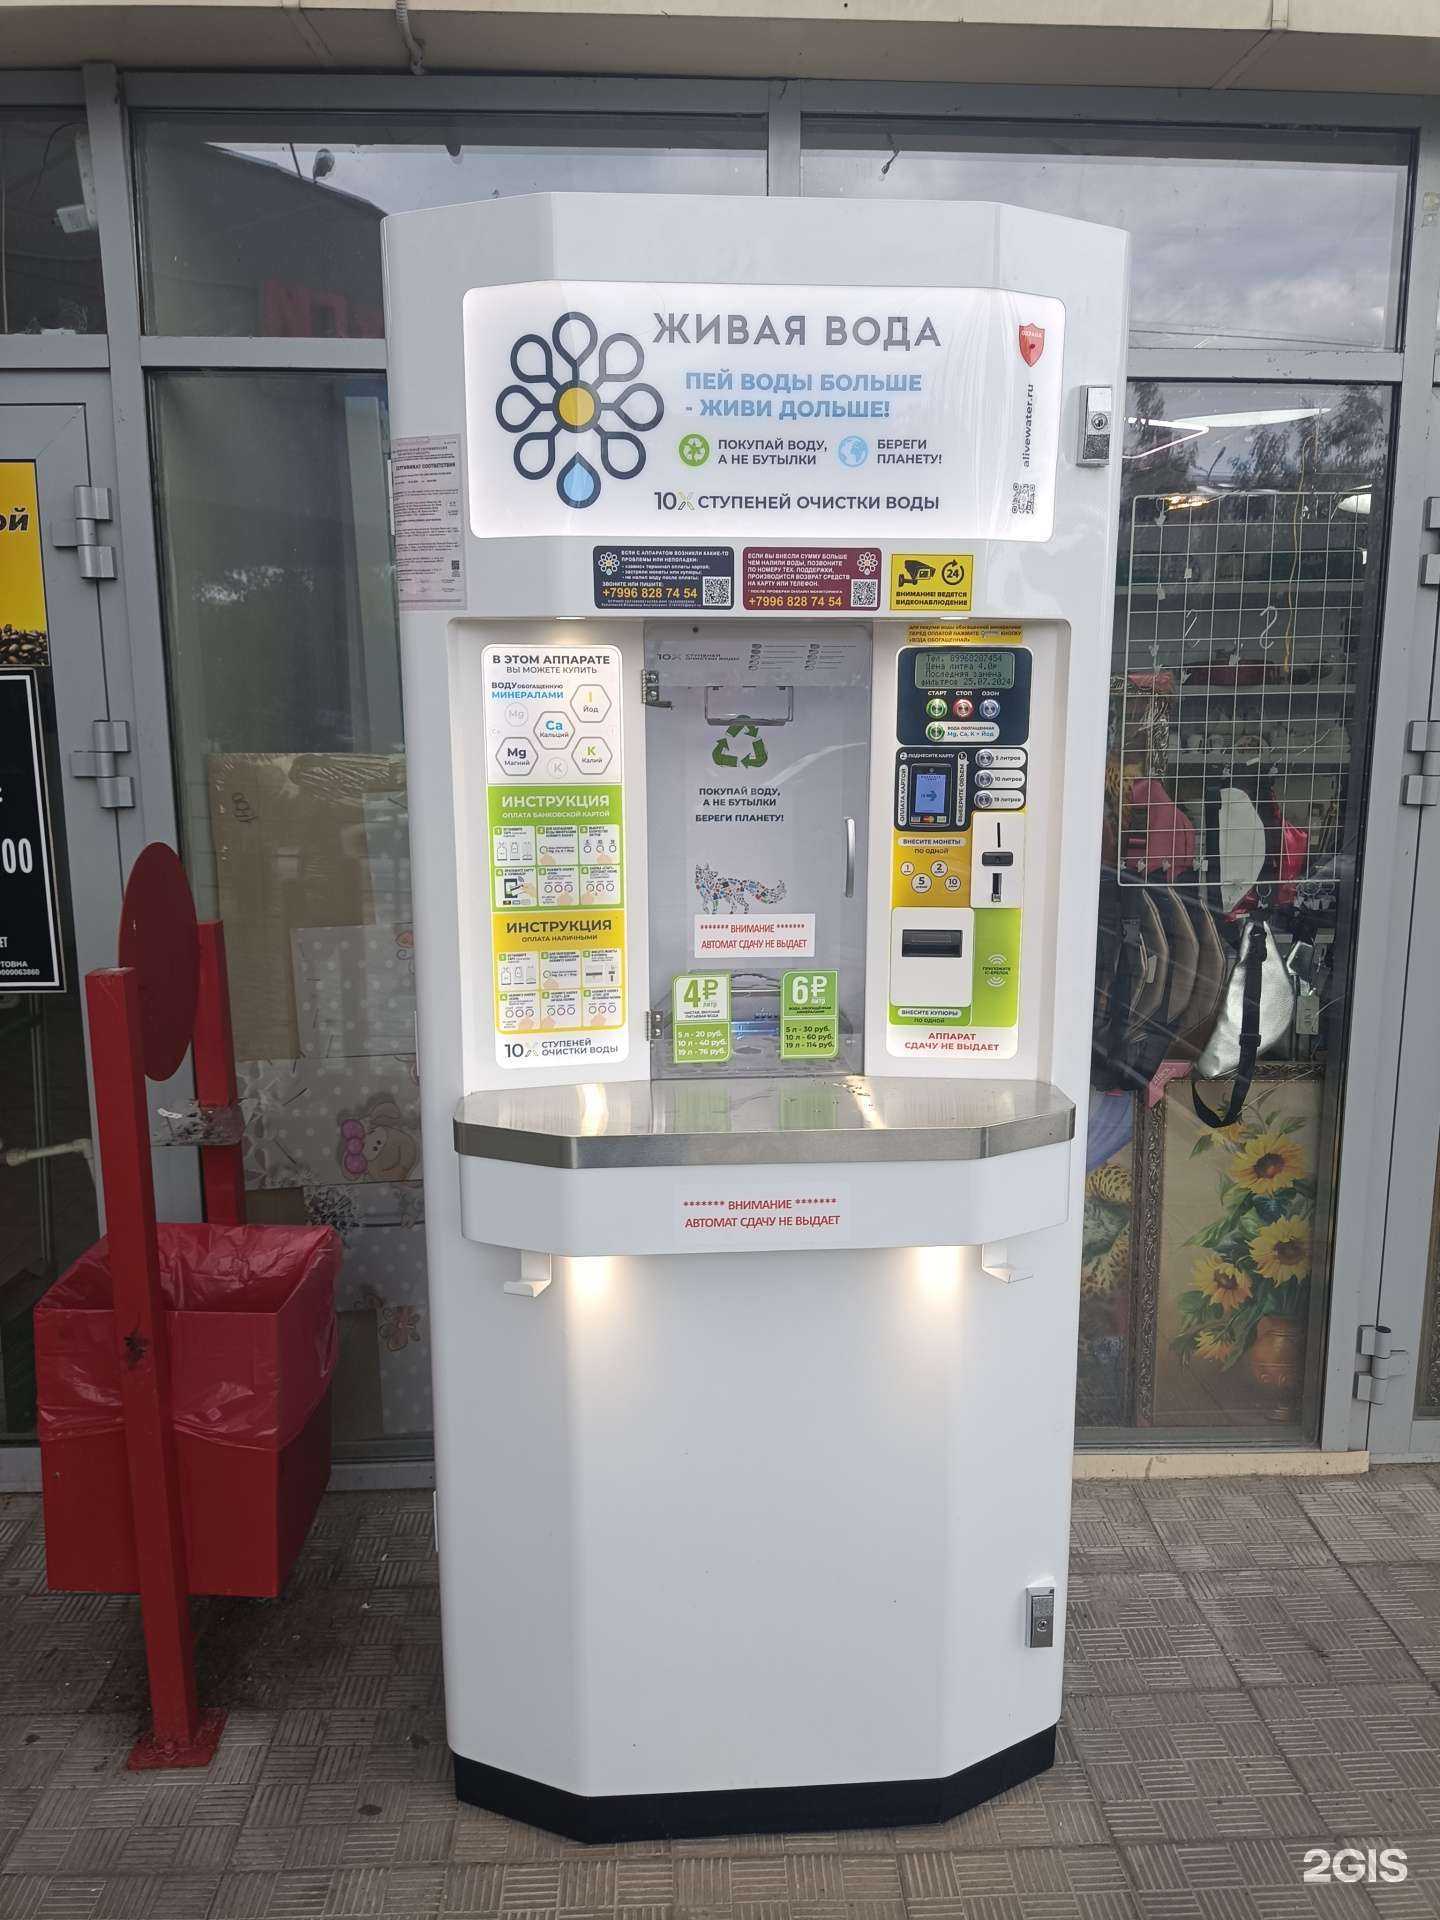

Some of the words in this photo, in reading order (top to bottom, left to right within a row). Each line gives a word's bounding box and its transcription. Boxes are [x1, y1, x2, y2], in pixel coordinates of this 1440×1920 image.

[652, 313, 806, 345] ЖИВАЯ
[825, 316, 941, 351] ВОДА
[686, 369, 733, 390] ПЕЙ
[740, 373, 812, 393] ВОДЫ
[820, 374, 922, 391] БОЛЬШЕ
[700, 400, 772, 417] ЖИВИ
[779, 400, 890, 420] ДОЛЬШЕ!
[1023, 384, 1034, 468] alivewater.ru
[718, 437, 782, 450] ПОКУПАЙ
[788, 440, 828, 453] ВОДУ,
[877, 439, 927, 450] БЕРЕГИ
[718, 455, 727, 465] А
[731, 455, 749, 465] НЕ
[752, 455, 817, 465] БУТЫЛКИ
[877, 454, 942, 465] ПЛАНЕТУ!
[697, 492, 791, 509] СТУПЕНЕЙ
[797, 496, 880, 510] ОЧИСТКИ
[886, 496, 940, 511] ВОДЫ
[946, 569, 959, 578] 24
[602, 588, 638, 598] +7996
[641, 588, 662, 598] 828
[666, 588, 680, 598] 74
[684, 588, 698, 598] 54
[749, 596, 783, 606] +7996
[787, 596, 807, 606] 828
[812, 597, 824, 606] 74
[828, 597, 842, 606] 54
[504, 655, 540, 664] ЭТОМ
[543, 655, 610, 664] АППАРАТЕ
[491, 682, 517, 690] ВОДУ
[491, 691, 563, 699] МИНЕРАЛАМИ
[546, 720, 563, 730] Ca
[507, 748, 526, 759] Mg
[699, 785, 747, 796] ПОКУПАЙ
[751, 788, 780, 797] ВОДУ,
[502, 795, 610, 808] ИНСТРУКЦИЯ
[696, 814, 732, 822] БЕРЕГИ
[735, 814, 784, 822] ПЛАНЕТУ!
[918, 877, 925, 885] 5
[507, 920, 612, 933] ИНСТРУКЦИЯ
[730, 924, 775, 933] ВНИМАНИЕ
[701, 940, 736, 949] АВТОМАТ
[739, 940, 763, 950] СДАЧУ
[765, 940, 775, 948] НЕ
[777, 940, 807, 949] ВЫДАЕТ
[814, 1025, 830, 1033] руб.
[818, 1033, 833, 1041] руб.
[928, 1032, 976, 1040] АППАРАТ
[542, 1037, 591, 1048] СТУПЕНЕЙ
[904, 1042, 939, 1050] СДАЧУ
[542, 1047, 587, 1056] ОЧИСТКИ
[728, 1200, 792, 1210] ВНИМАНИЕ
[685, 1218, 737, 1228] АВТОМАТ
[740, 1217, 776, 1229] СДАЧУ
[779, 1216, 792, 1226] НЕ
[795, 1215, 841, 1227] ВЫДАЕТ
